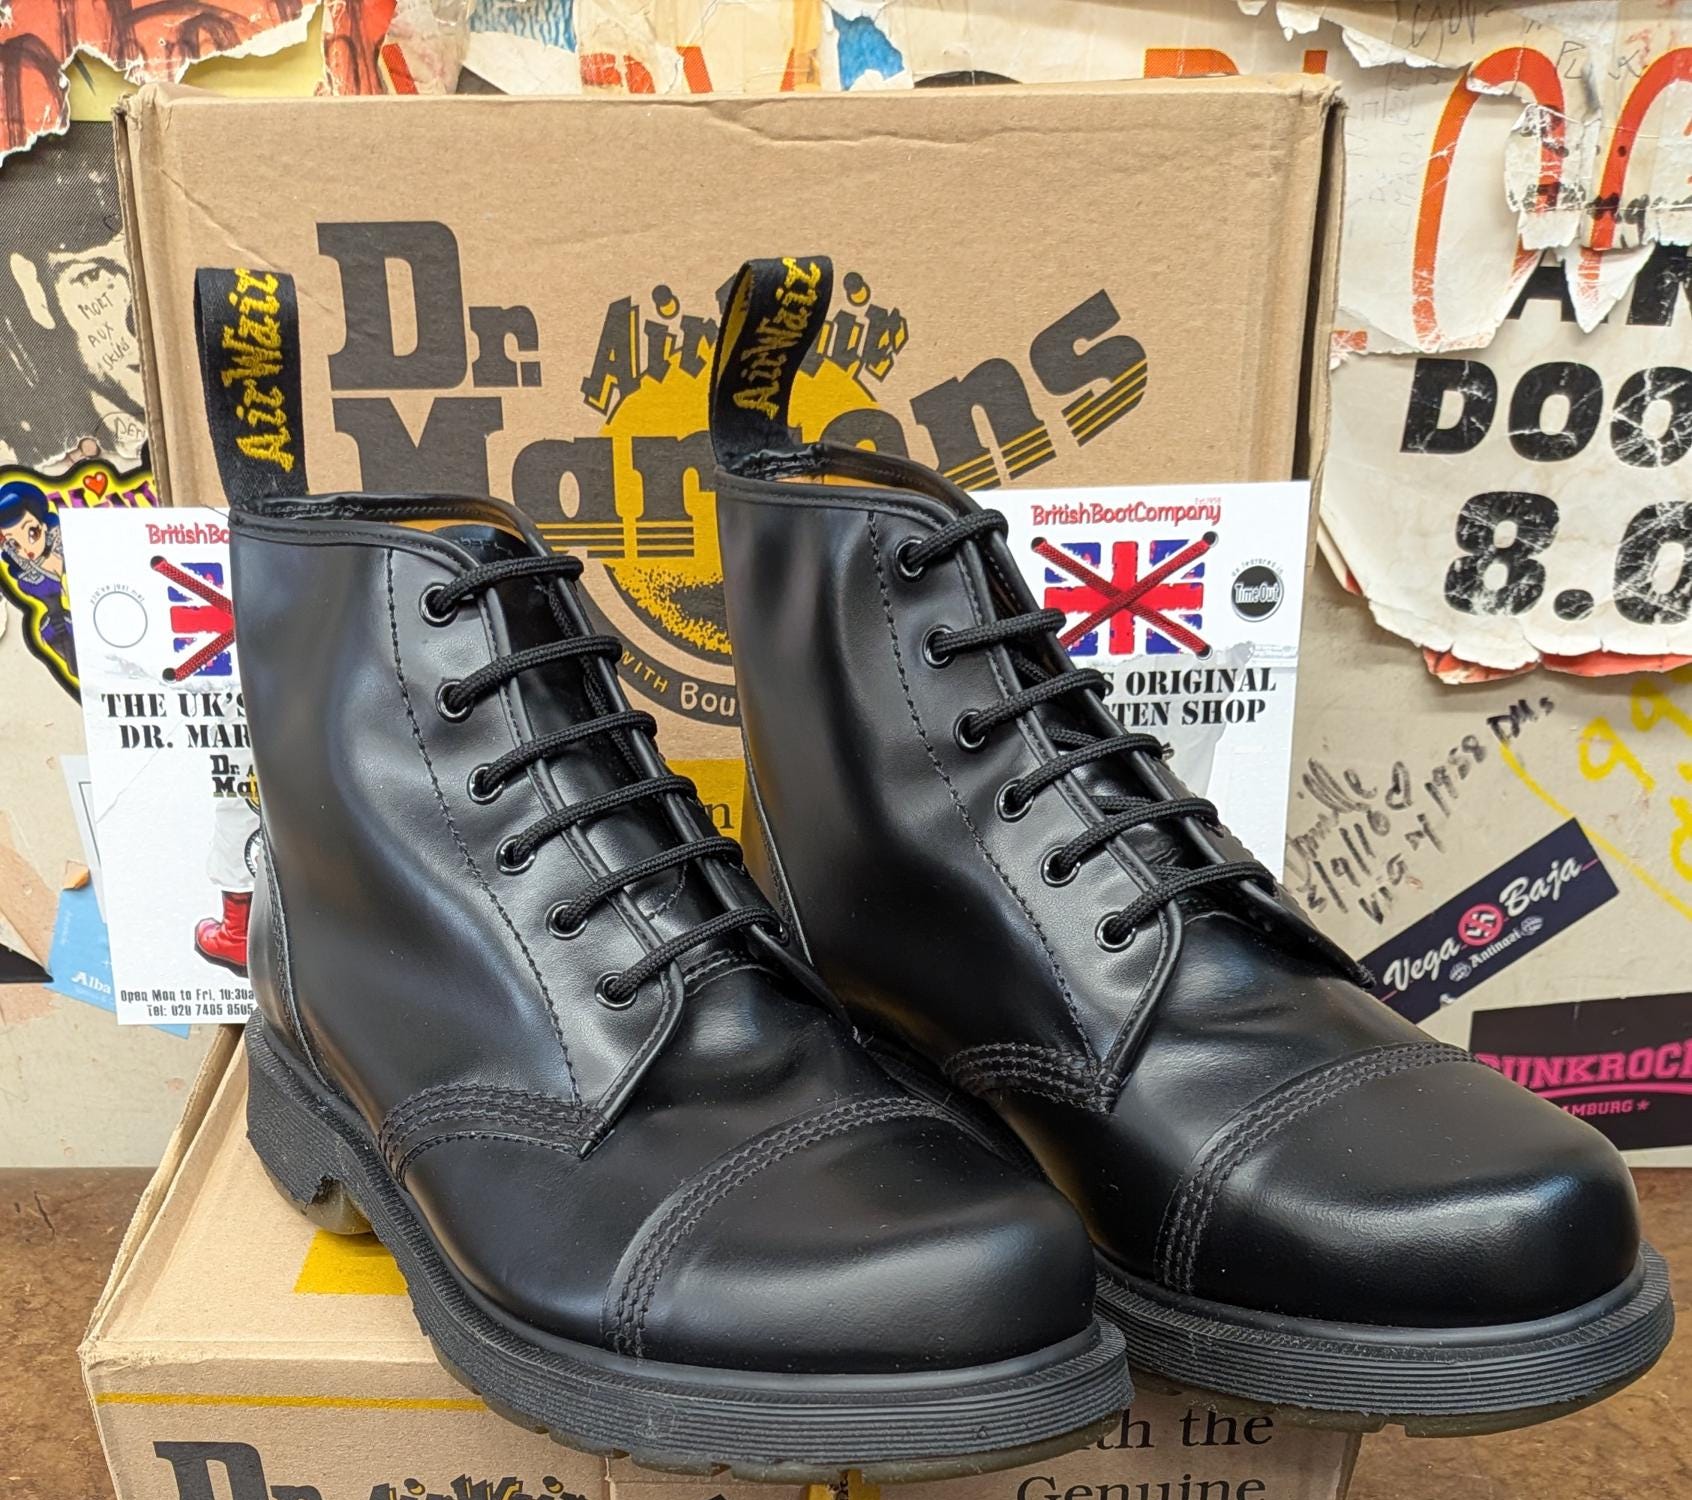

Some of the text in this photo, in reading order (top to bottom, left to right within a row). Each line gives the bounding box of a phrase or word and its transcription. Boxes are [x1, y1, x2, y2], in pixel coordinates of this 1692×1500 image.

[317, 221, 541, 390] Dr.
[733, 256, 821, 421] AirWair
[219, 267, 295, 473] AirWair
[1400, 358, 1692, 468] DOO
[1031, 501, 1221, 526] BritishBootCompany
[1444, 490, 1692, 625] 8.0
[617, 648, 669, 694] WITH
[1126, 667, 1277, 696] ORIGINAL
[101, 693, 167, 718] THE
[1112, 699, 1266, 727] TEN SHOP
[119, 724, 252, 749] DR. MAR
[210, 754, 241, 776] Dr.
[1382, 856, 1583, 991] Vega Baja
[120, 990, 148, 1003] Open
[152, 989, 176, 1001] Mon
[180, 990, 192, 1001] to
[219, 988, 255, 1001] 10:30a
[147, 1004, 167, 1017] Tel:
[171, 1004, 192, 1017] 020
[1562, 1099, 1634, 1117] MBURG
[1179, 1404, 1274, 1447] the
